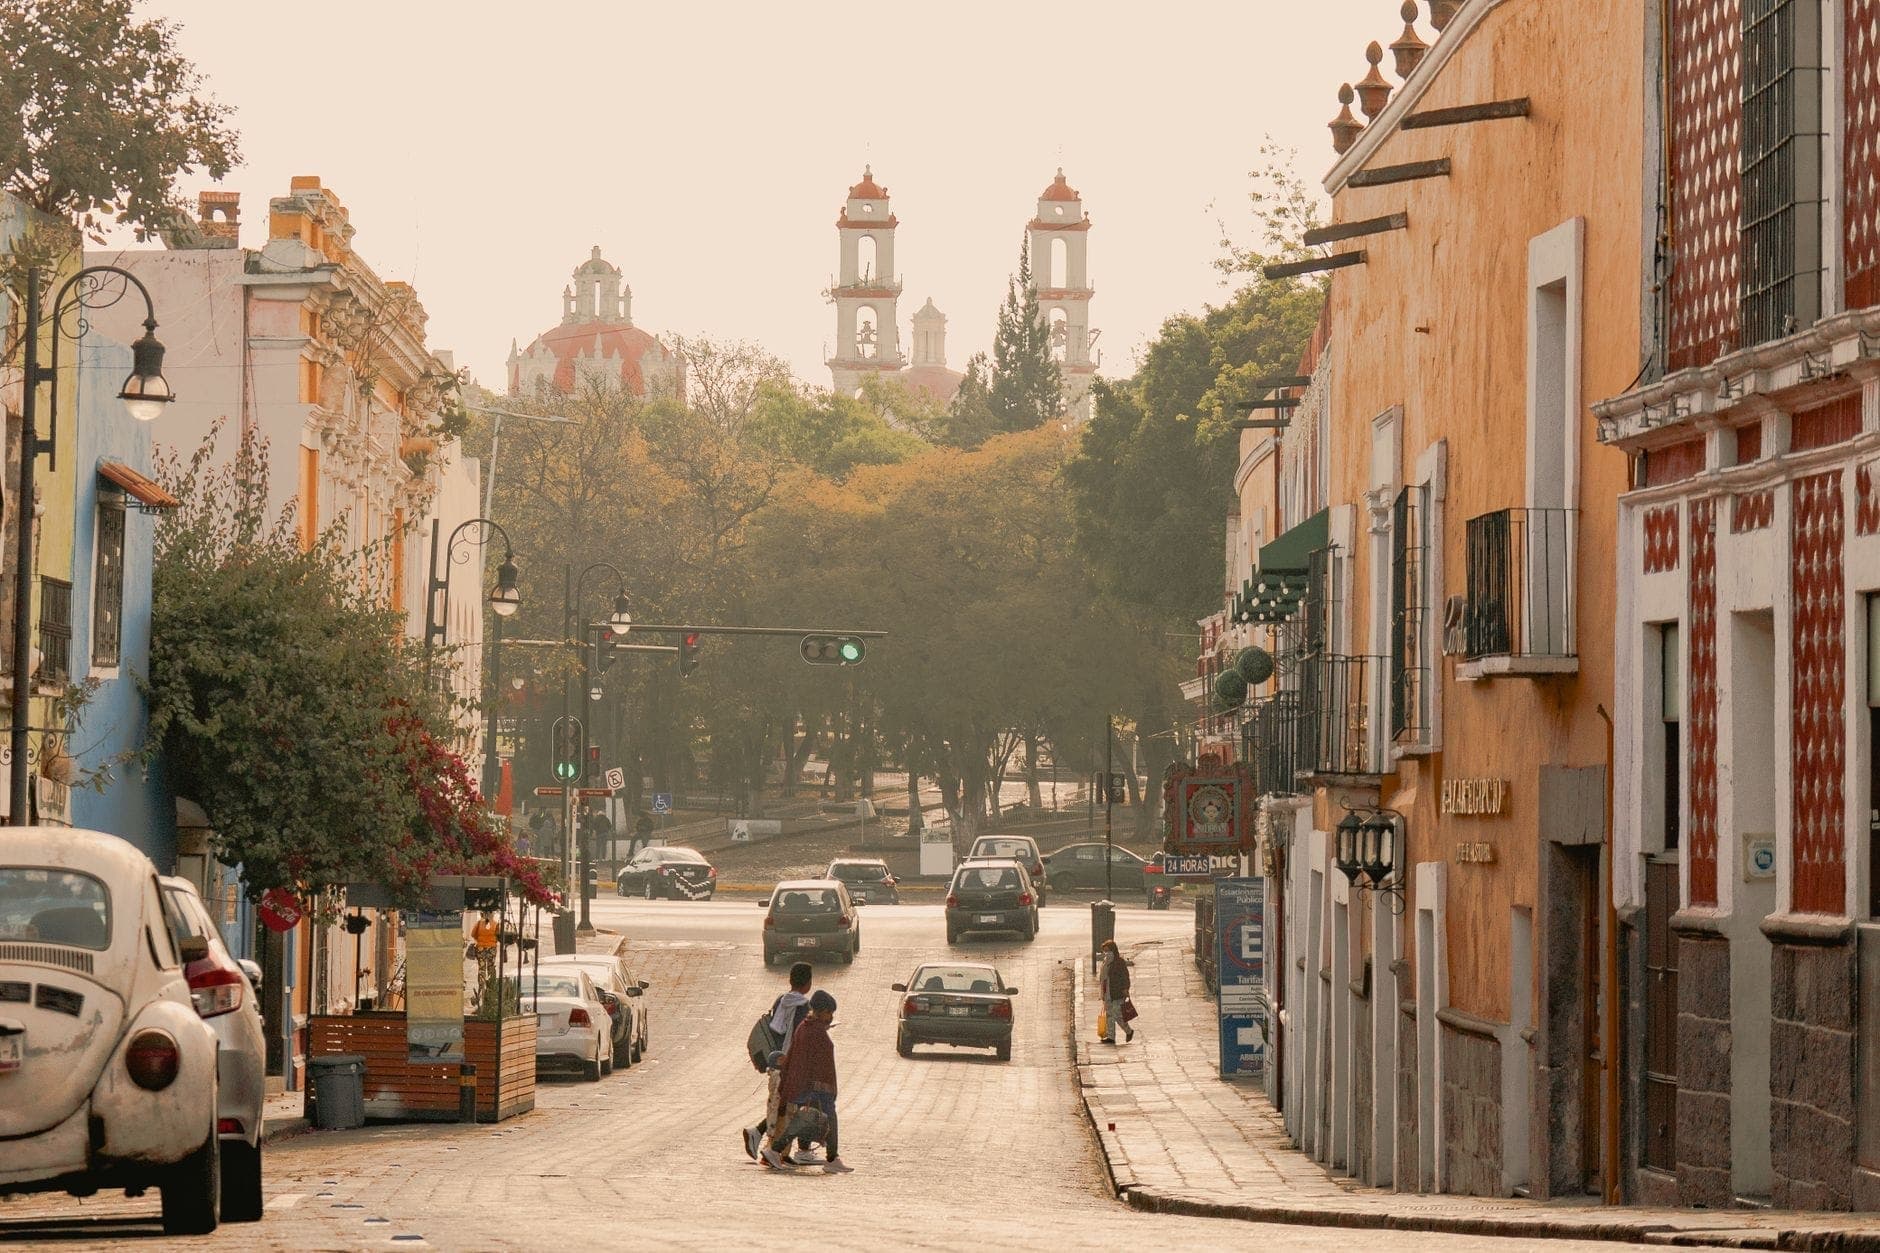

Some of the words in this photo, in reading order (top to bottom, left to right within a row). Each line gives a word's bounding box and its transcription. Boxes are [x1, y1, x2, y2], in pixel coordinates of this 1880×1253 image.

[1168, 860, 1177, 872] 24
[1180, 859, 1208, 872] HORAS
[1241, 925, 1262, 958] E
